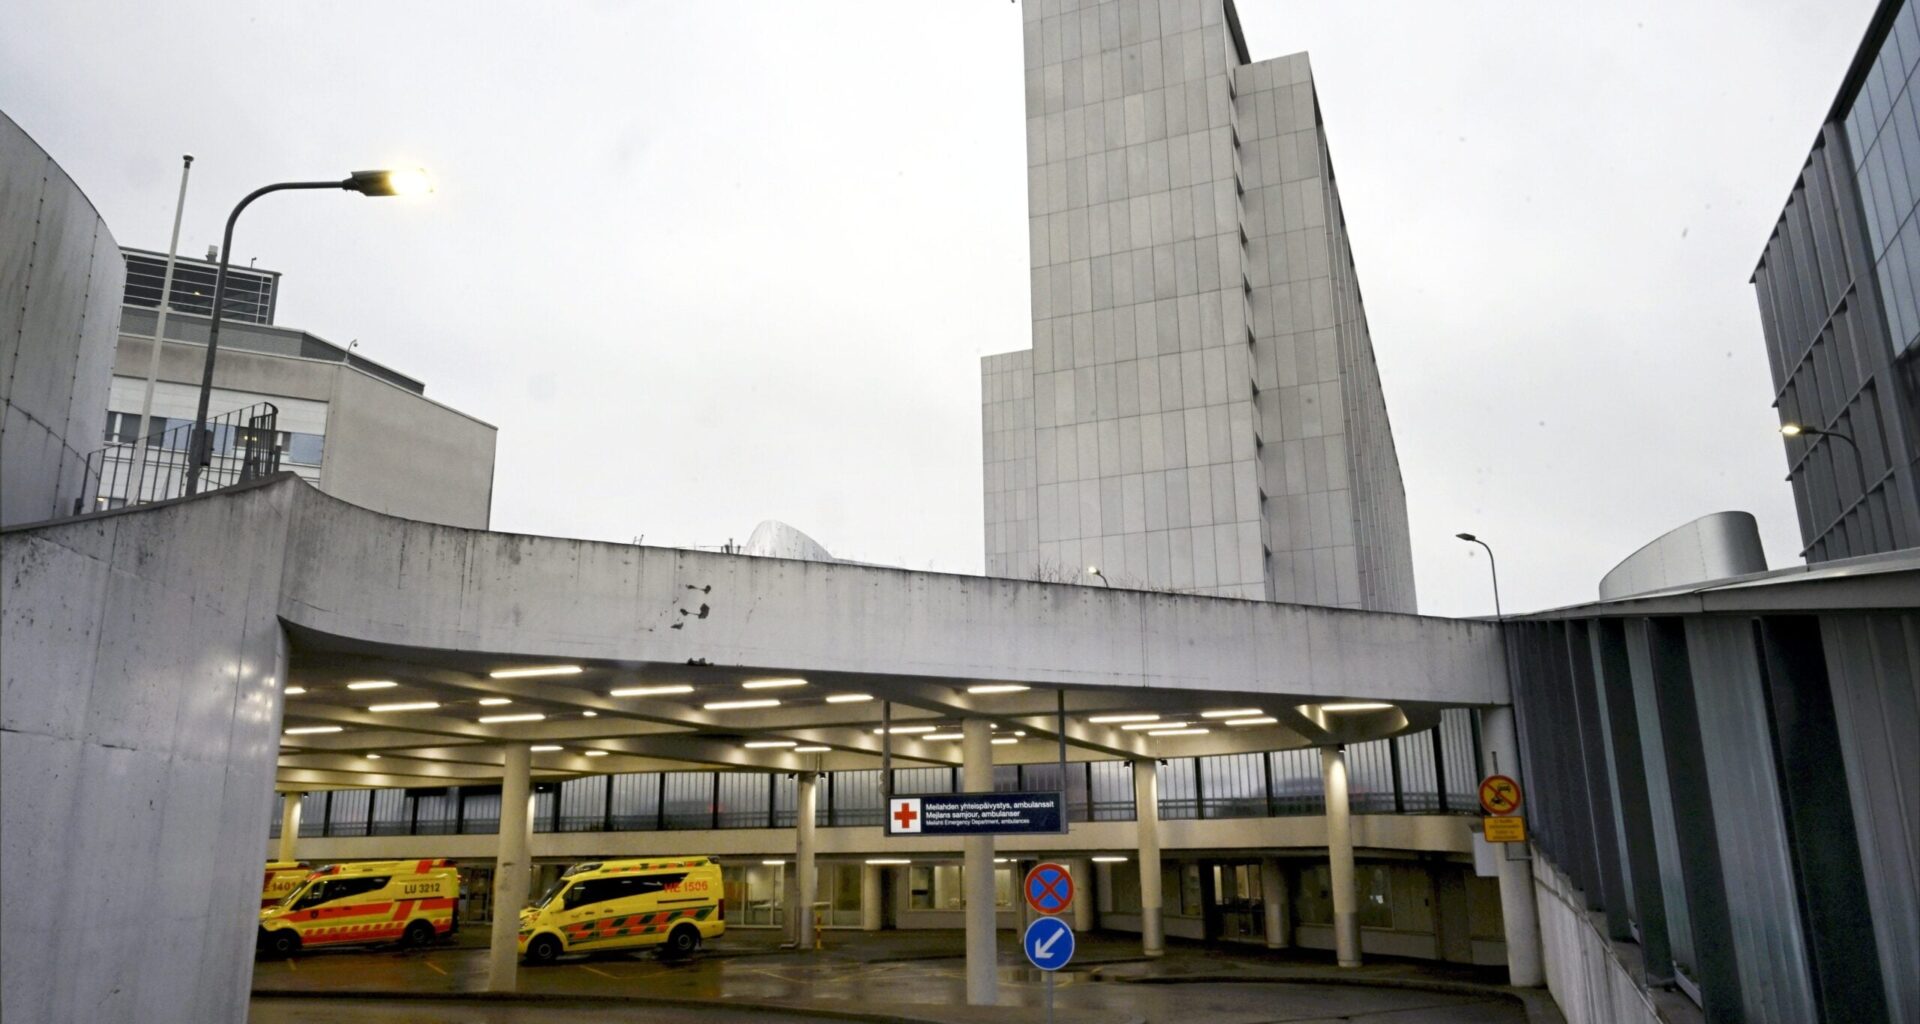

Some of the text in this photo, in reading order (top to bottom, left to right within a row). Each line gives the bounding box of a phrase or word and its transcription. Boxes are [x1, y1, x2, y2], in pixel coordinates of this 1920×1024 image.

[960, 802, 1012, 812] yhteispäivystys,
[1013, 801, 1054, 809] ambulanssit
[952, 811, 980, 819] samjour,
[981, 810, 1020, 818] ambulanser
[945, 819, 970, 827] Emergency
[972, 818, 999, 826] Department,
[404, 882, 440, 894] LU 3212
[663, 881, 681, 893] HE
